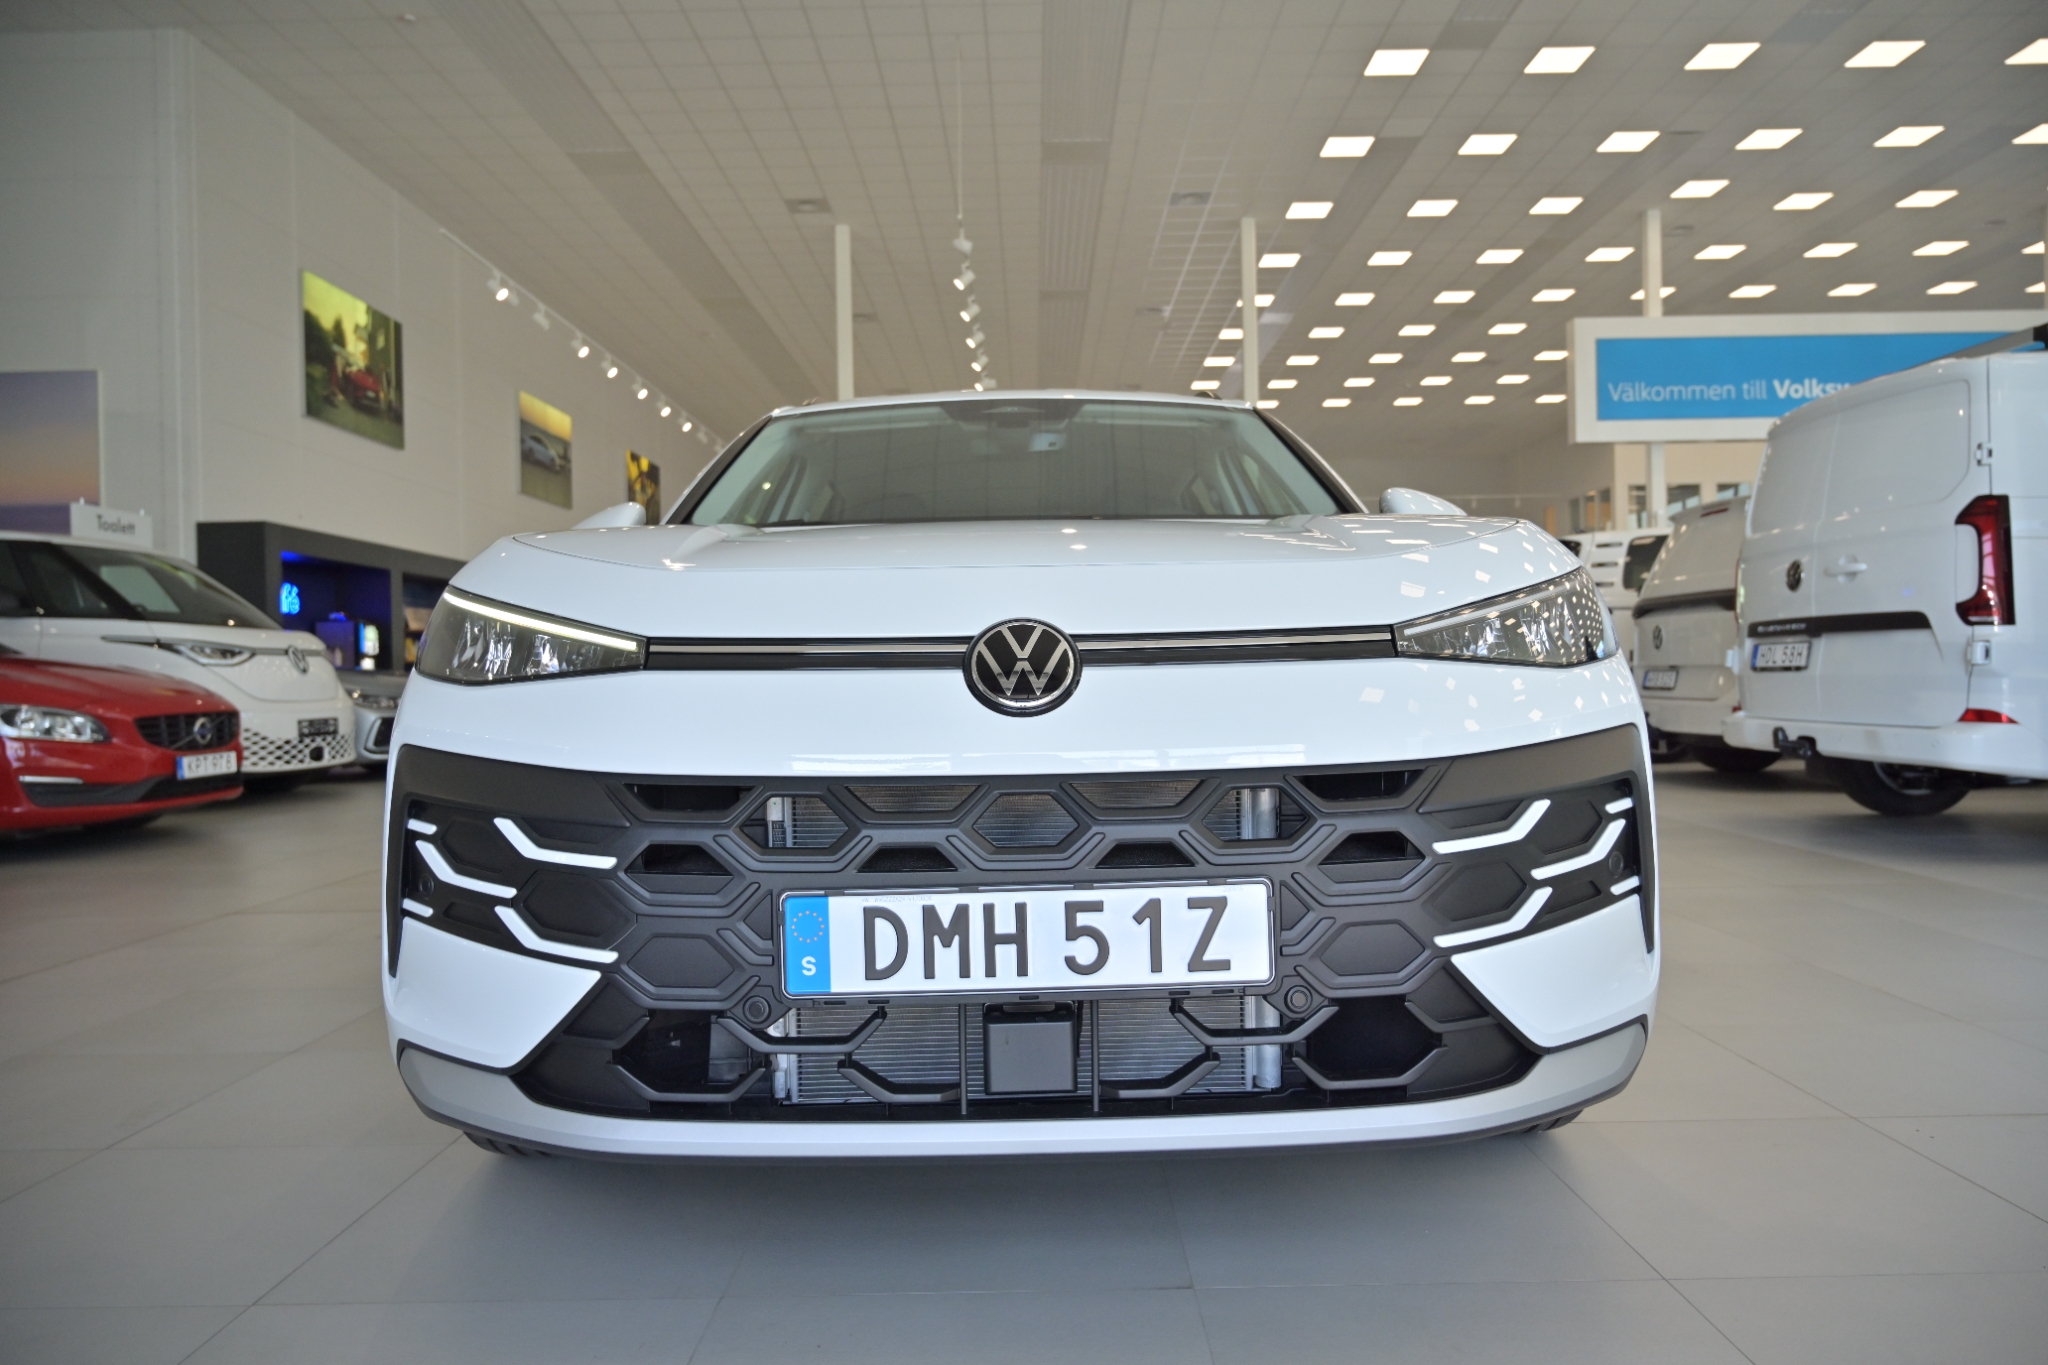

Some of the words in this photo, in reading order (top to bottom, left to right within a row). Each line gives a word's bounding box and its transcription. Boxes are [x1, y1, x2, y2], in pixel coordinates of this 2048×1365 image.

[1607, 382, 1736, 402] Välkommen
[1742, 380, 1767, 400] till
[1773, 378, 1850, 399] Volks
[1759, 646, 1777, 665] HDL
[863, 902, 1029, 981] DMH
[1064, 896, 1232, 976] 51Z
[801, 955, 817, 976] S
